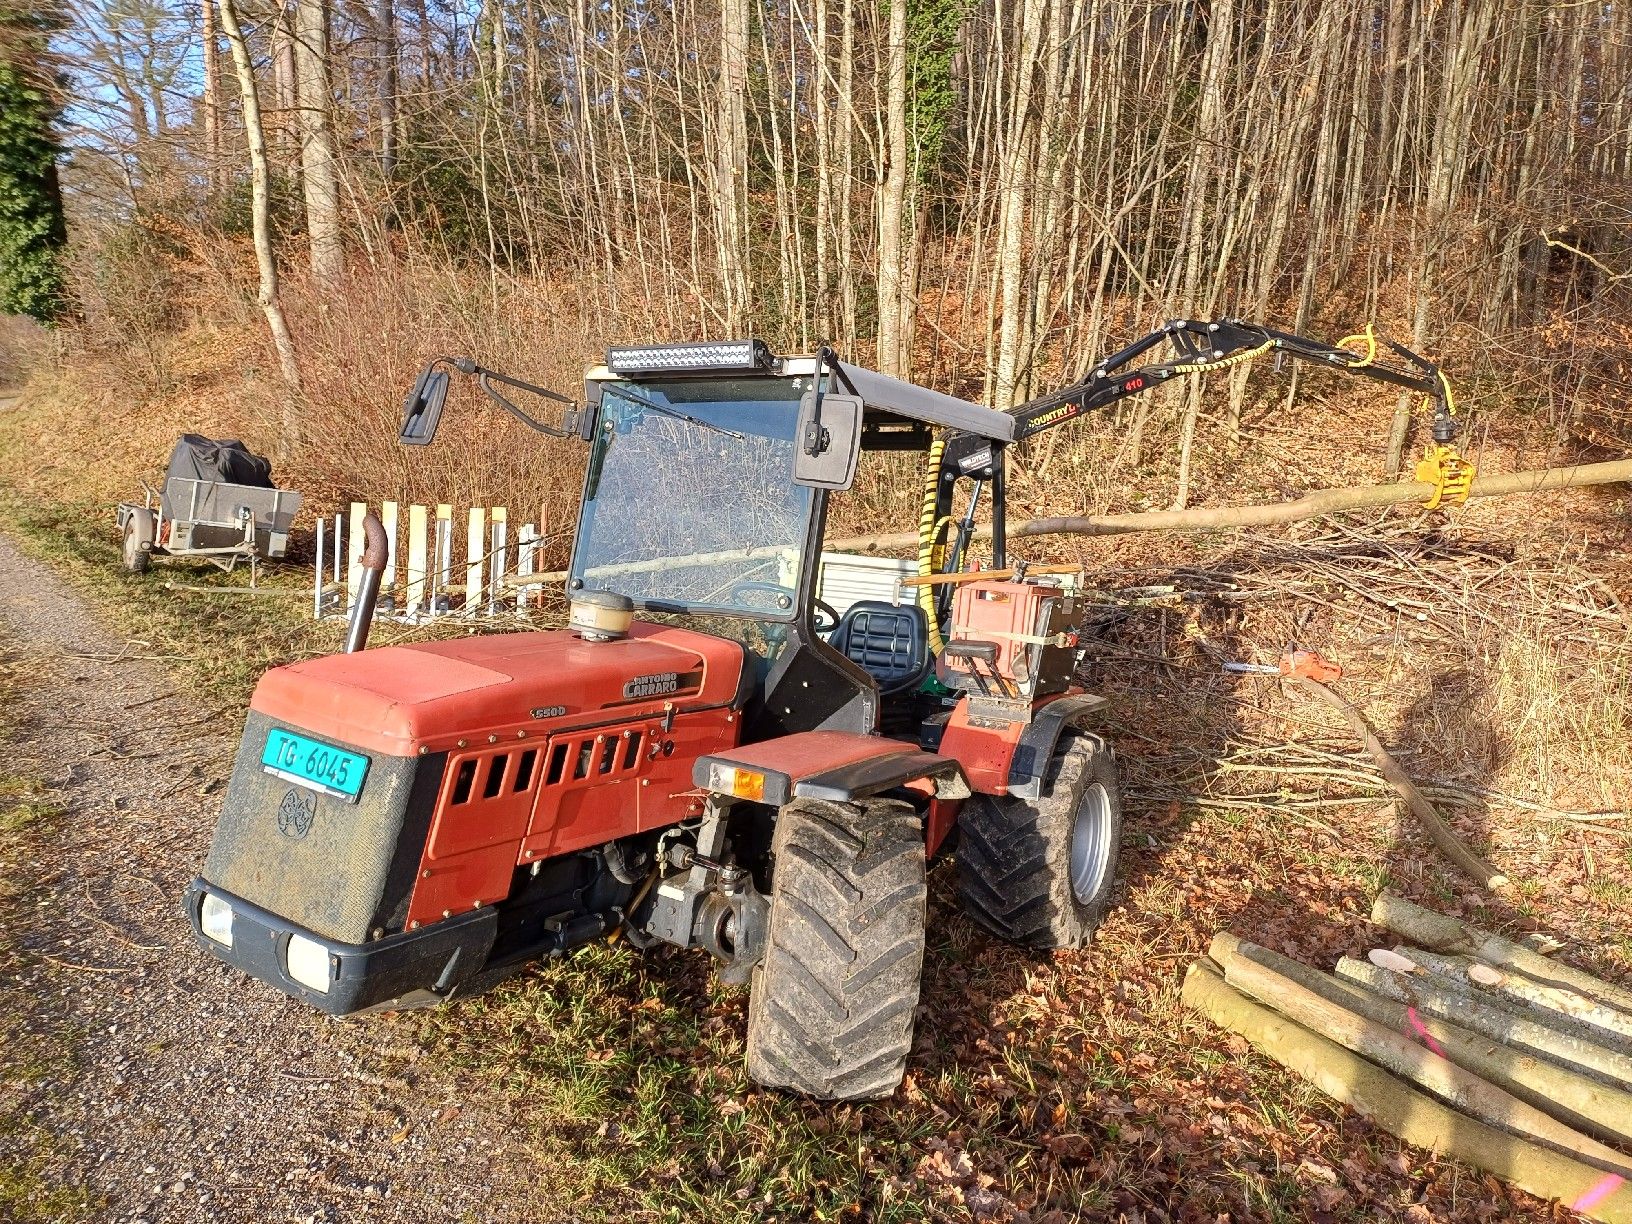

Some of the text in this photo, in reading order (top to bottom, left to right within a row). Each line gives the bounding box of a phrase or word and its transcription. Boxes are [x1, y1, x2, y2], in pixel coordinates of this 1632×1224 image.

[1125, 379, 1143, 391] 410
[623, 680, 677, 698] CARRARO
[536, 706, 566, 719] 5500
